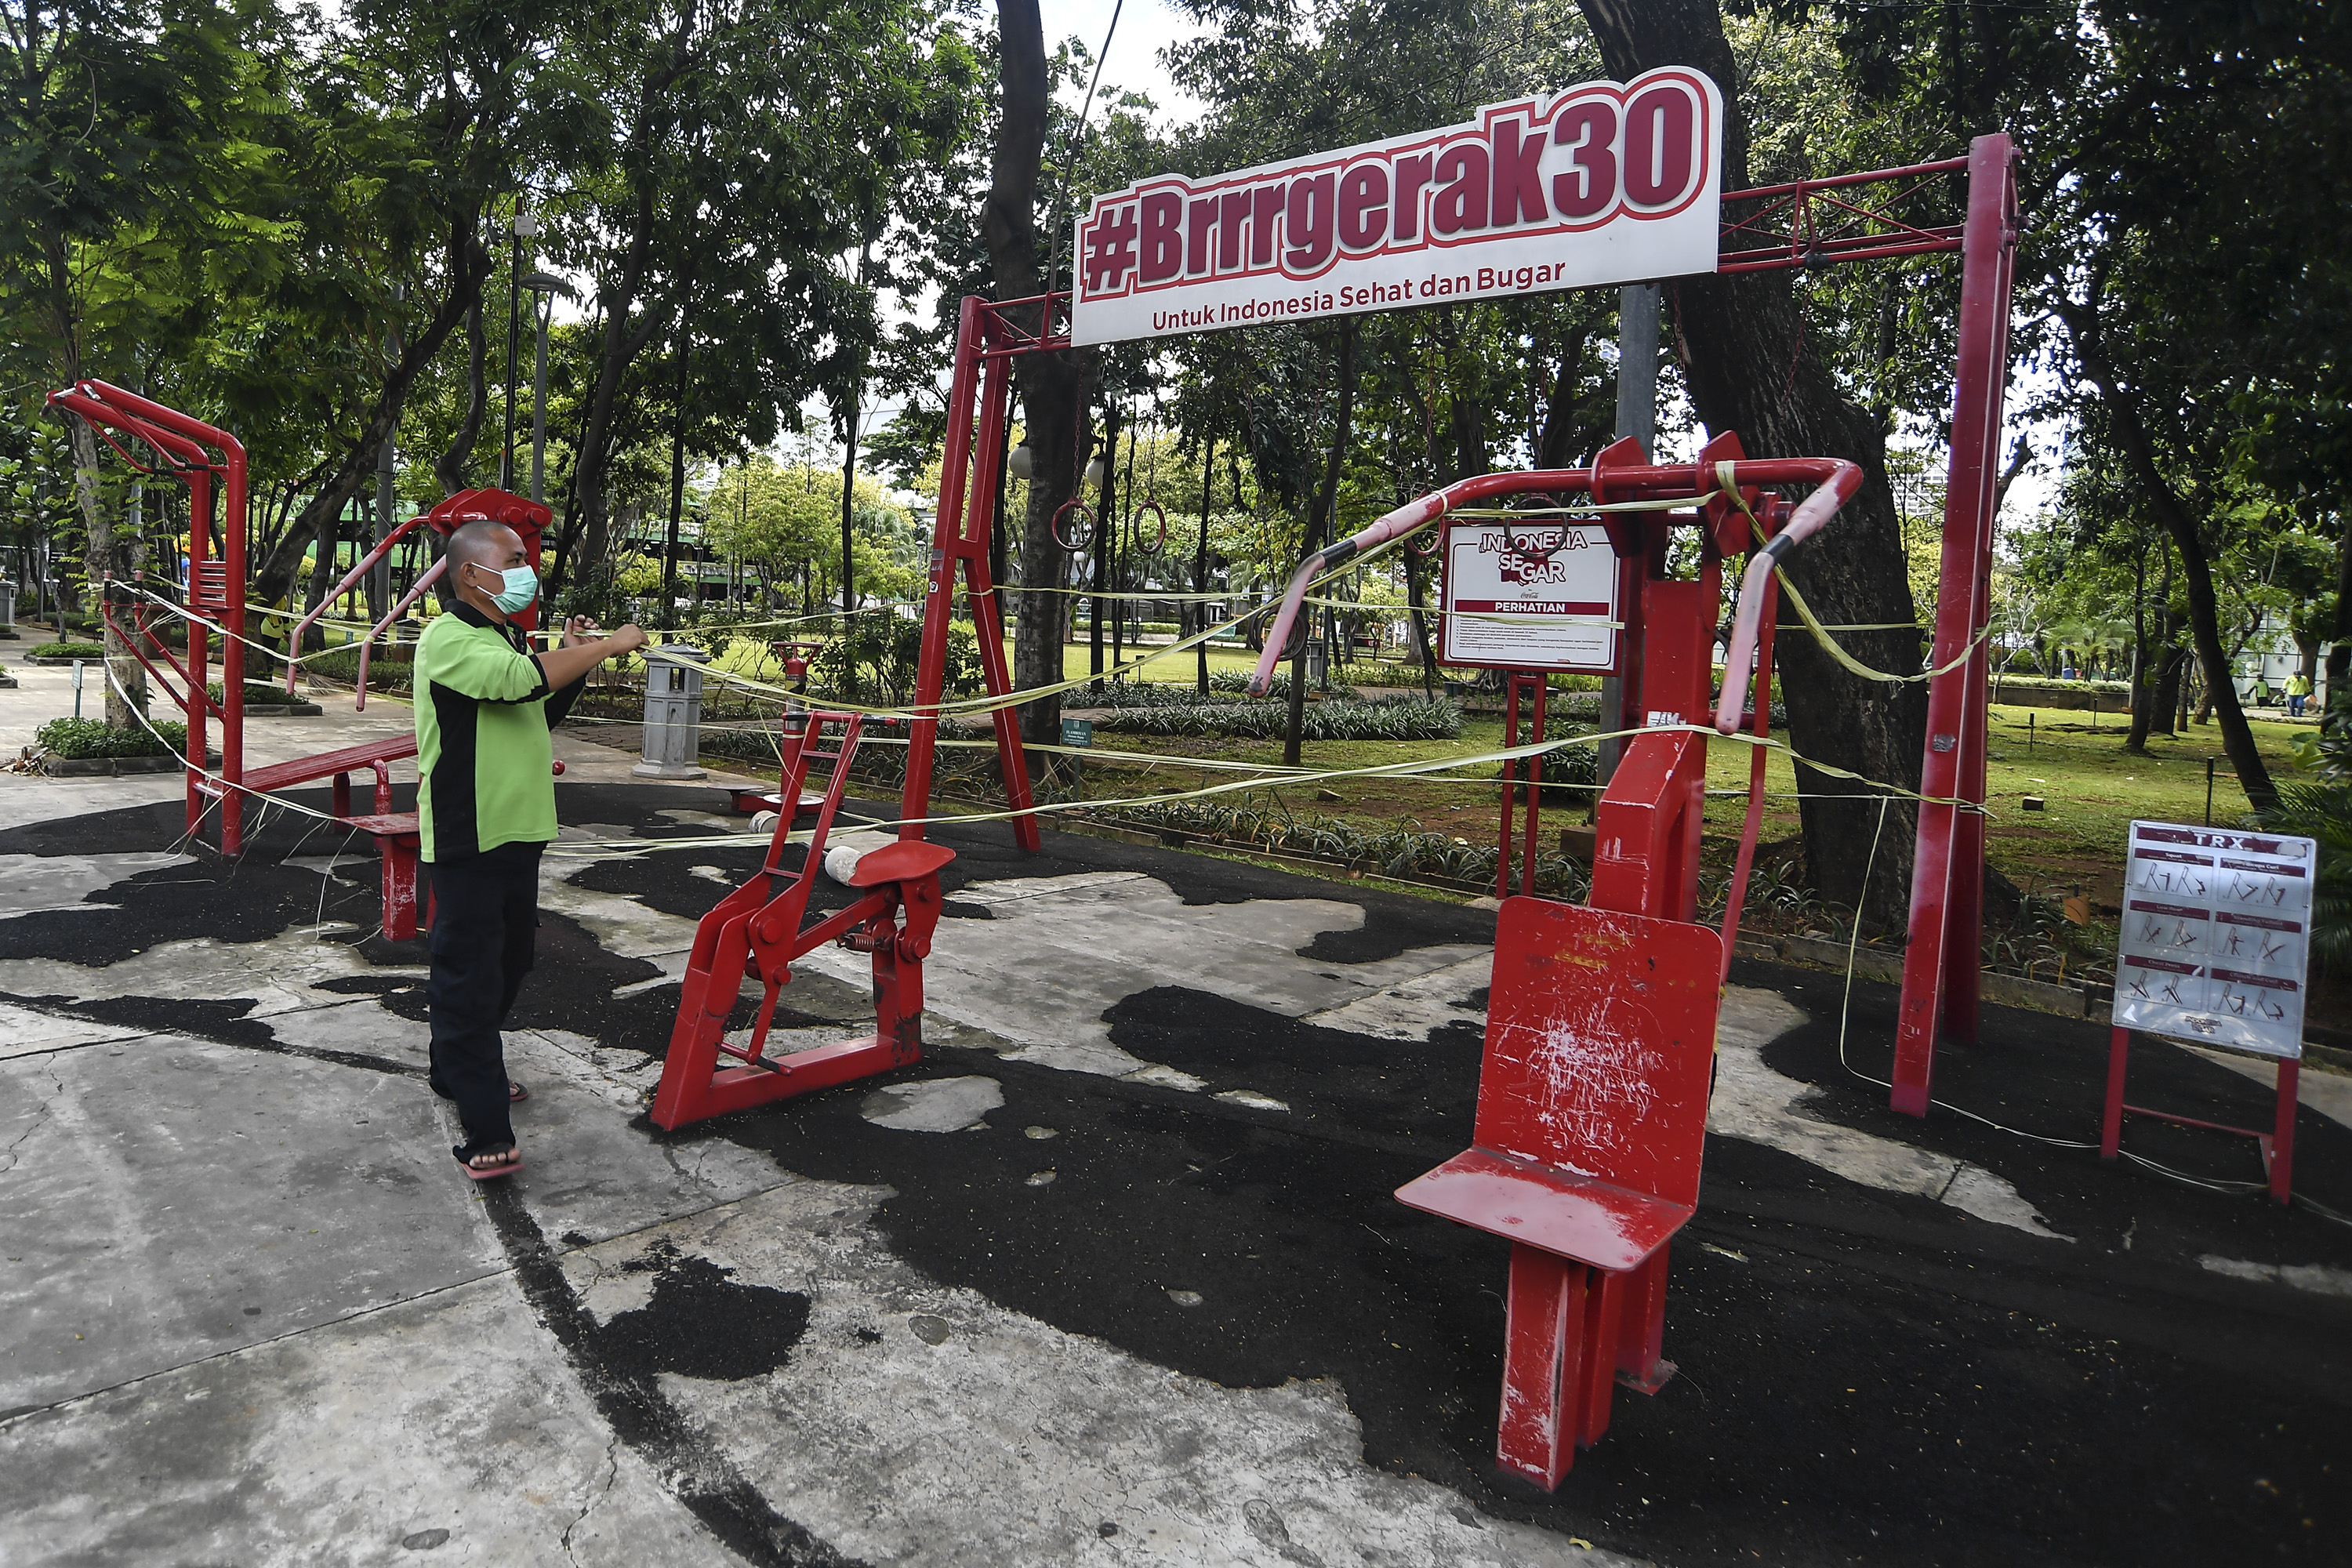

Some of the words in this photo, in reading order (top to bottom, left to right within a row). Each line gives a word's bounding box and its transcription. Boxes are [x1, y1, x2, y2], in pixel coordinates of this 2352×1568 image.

[1085, 85, 1693, 292] #Brrrgerak30
[1152, 303, 1215, 332] Untuk
[1220, 293, 1334, 323] Indonesia
[1339, 278, 1413, 309] Sehat
[1419, 273, 1471, 298] dan
[1476, 261, 1566, 294] Bugar
[1494, 601, 1566, 613] PERHATIAN
[2194, 832, 2245, 851] TRX
